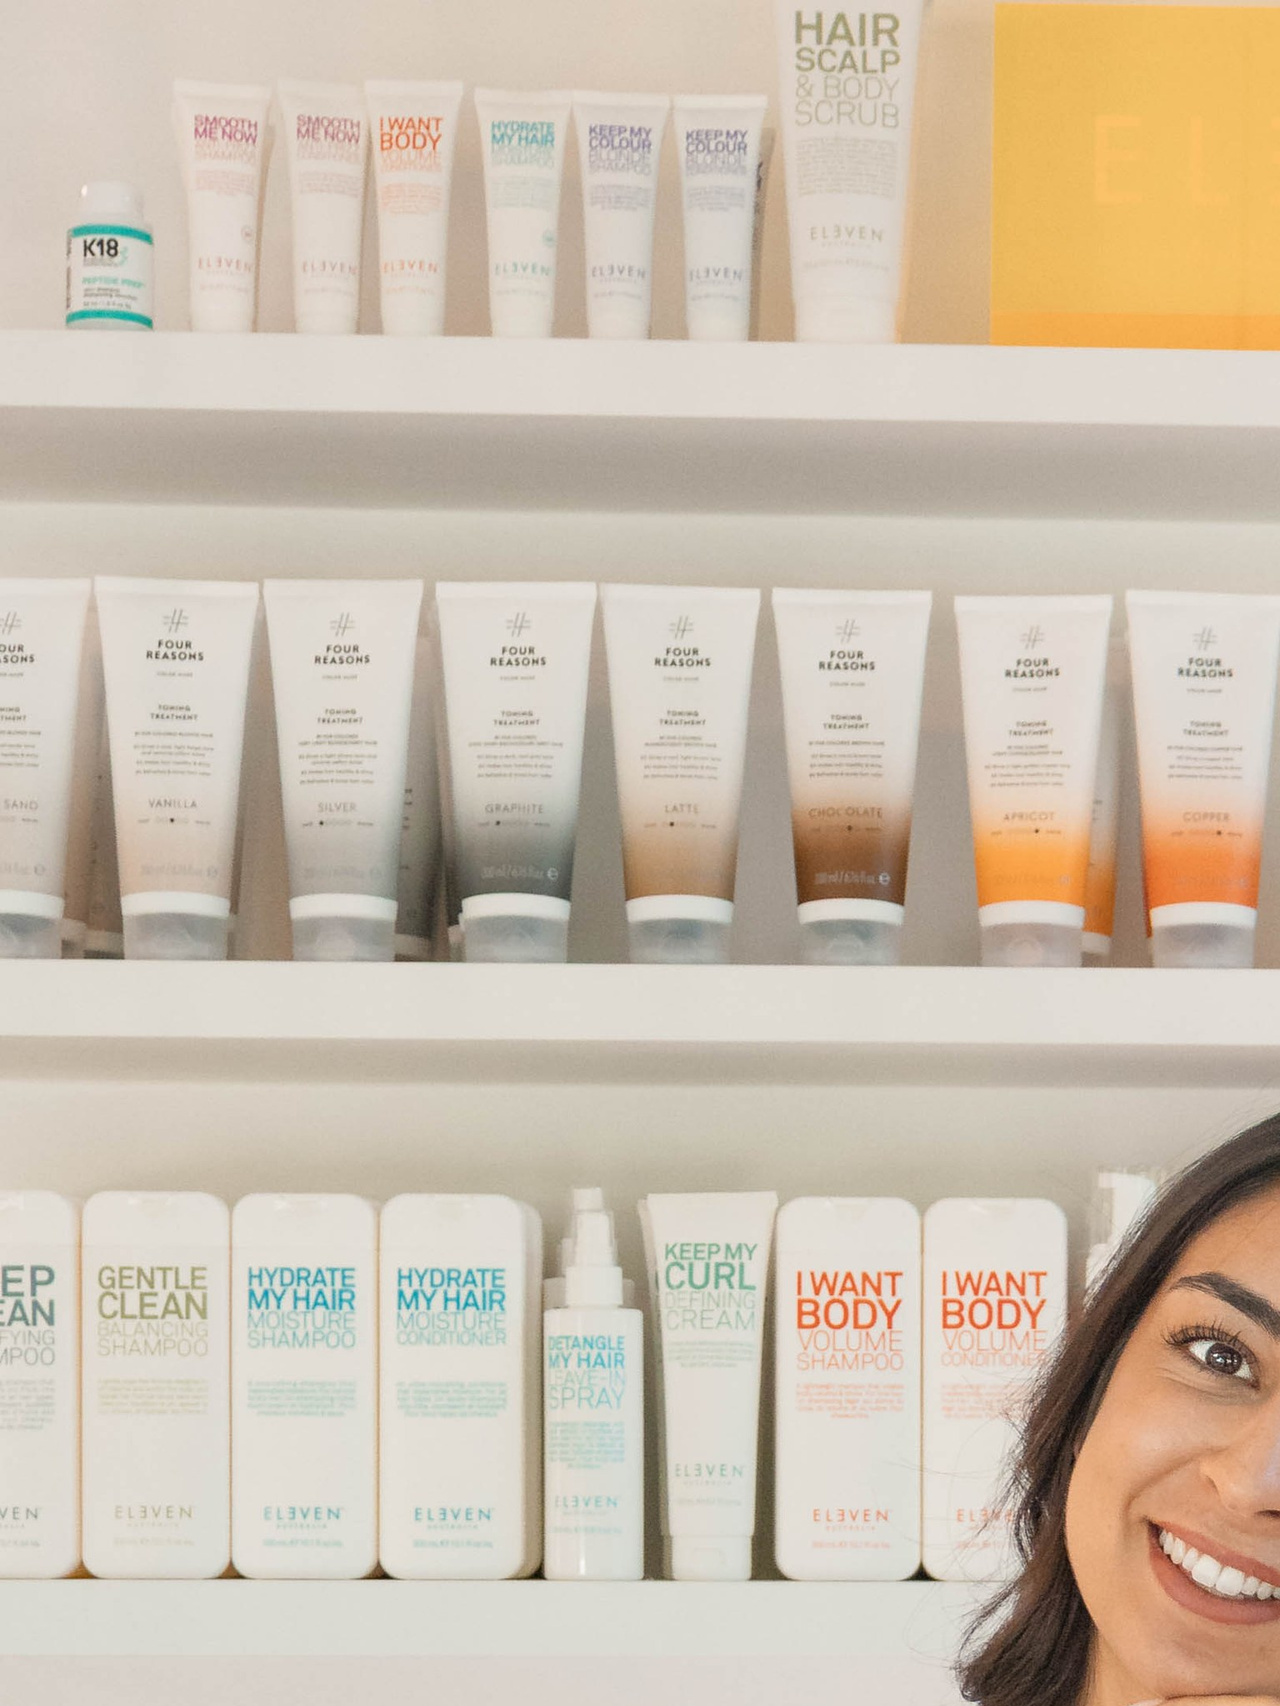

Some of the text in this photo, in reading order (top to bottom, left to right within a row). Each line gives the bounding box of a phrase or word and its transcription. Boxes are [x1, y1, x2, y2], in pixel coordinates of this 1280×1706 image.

[795, 11, 900, 47] HAIR
[795, 47, 900, 74] SCALP
[796, 75, 900, 101] & BODY
[194, 115, 258, 131] SMOOTH
[297, 115, 360, 131] SMOOTH
[795, 101, 899, 129] SCRUB
[380, 117, 443, 131] I WANT
[491, 120, 555, 134] HYDRATE
[589, 124, 652, 138] KEEP MY
[194, 127, 258, 147] ME NOW
[297, 127, 360, 145] ME NOW
[380, 132, 442, 151] BODY
[491, 132, 556, 148] MY HAIR
[589, 136, 652, 152] COLOUR
[686, 129, 748, 142] KEEP MY
[686, 141, 747, 155] COLOUR
[83, 238, 118, 258] K18
[158, 639, 192, 650] FOUR
[326, 644, 360, 654] FOUR
[502, 646, 535, 655] FOUR
[665, 647, 699, 657] FOUR
[146, 649, 204, 661] REASONS
[314, 654, 370, 665] REASONS
[490, 656, 547, 666] REASONS
[654, 657, 711, 667] REASONS
[830, 650, 864, 660] FOUR
[1016, 658, 1049, 668] FOUR
[1188, 657, 1222, 667] FOUR
[818, 661, 876, 672] REASONS
[1005, 668, 1060, 678] REASONS
[1177, 667, 1233, 678] REASONS
[148, 799, 197, 809] VANILLA
[318, 802, 357, 813] SILVER
[484, 803, 544, 814] GRAPHITE
[664, 805, 700, 815] LATTE
[808, 806, 883, 819] CHOCOLATE
[1003, 811, 1055, 822] APRICOT
[1183, 812, 1230, 822] COPPER
[665, 1243, 757, 1261] KEEP MY
[1, 1264, 55, 1297] EP
[98, 1266, 208, 1291] GENTLE
[248, 1267, 355, 1288] HYDRATE
[397, 1268, 505, 1289] HYDRATE
[666, 1262, 756, 1291] CURL
[797, 1271, 904, 1296] I WANT
[942, 1271, 1047, 1296] I WANT
[99, 1292, 208, 1320] CLEAN
[248, 1289, 355, 1311] MY HAIR
[397, 1289, 505, 1312] MY HAIR
[665, 1291, 756, 1310] DEFINING
[248, 1311, 355, 1330] MOISTURE
[397, 1312, 505, 1331] MOISTURE
[666, 1310, 756, 1331] CREAM
[797, 1300, 903, 1330] BODY
[942, 1300, 1047, 1330] BODY
[98, 1321, 208, 1338] BALANCING
[98, 1337, 208, 1357] SHAMPOO
[247, 1331, 355, 1349] SHAMPOO
[397, 1330, 506, 1347] CONDITIONER
[548, 1336, 625, 1352] DETANGLE
[797, 1331, 904, 1351] VOLUME
[942, 1330, 1047, 1351] VOLUME
[549, 1353, 625, 1369] MY HAIR
[797, 1352, 904, 1371] SHAMPOO
[549, 1369, 625, 1387] LEAVE-IN
[548, 1388, 625, 1409] SPRAY
